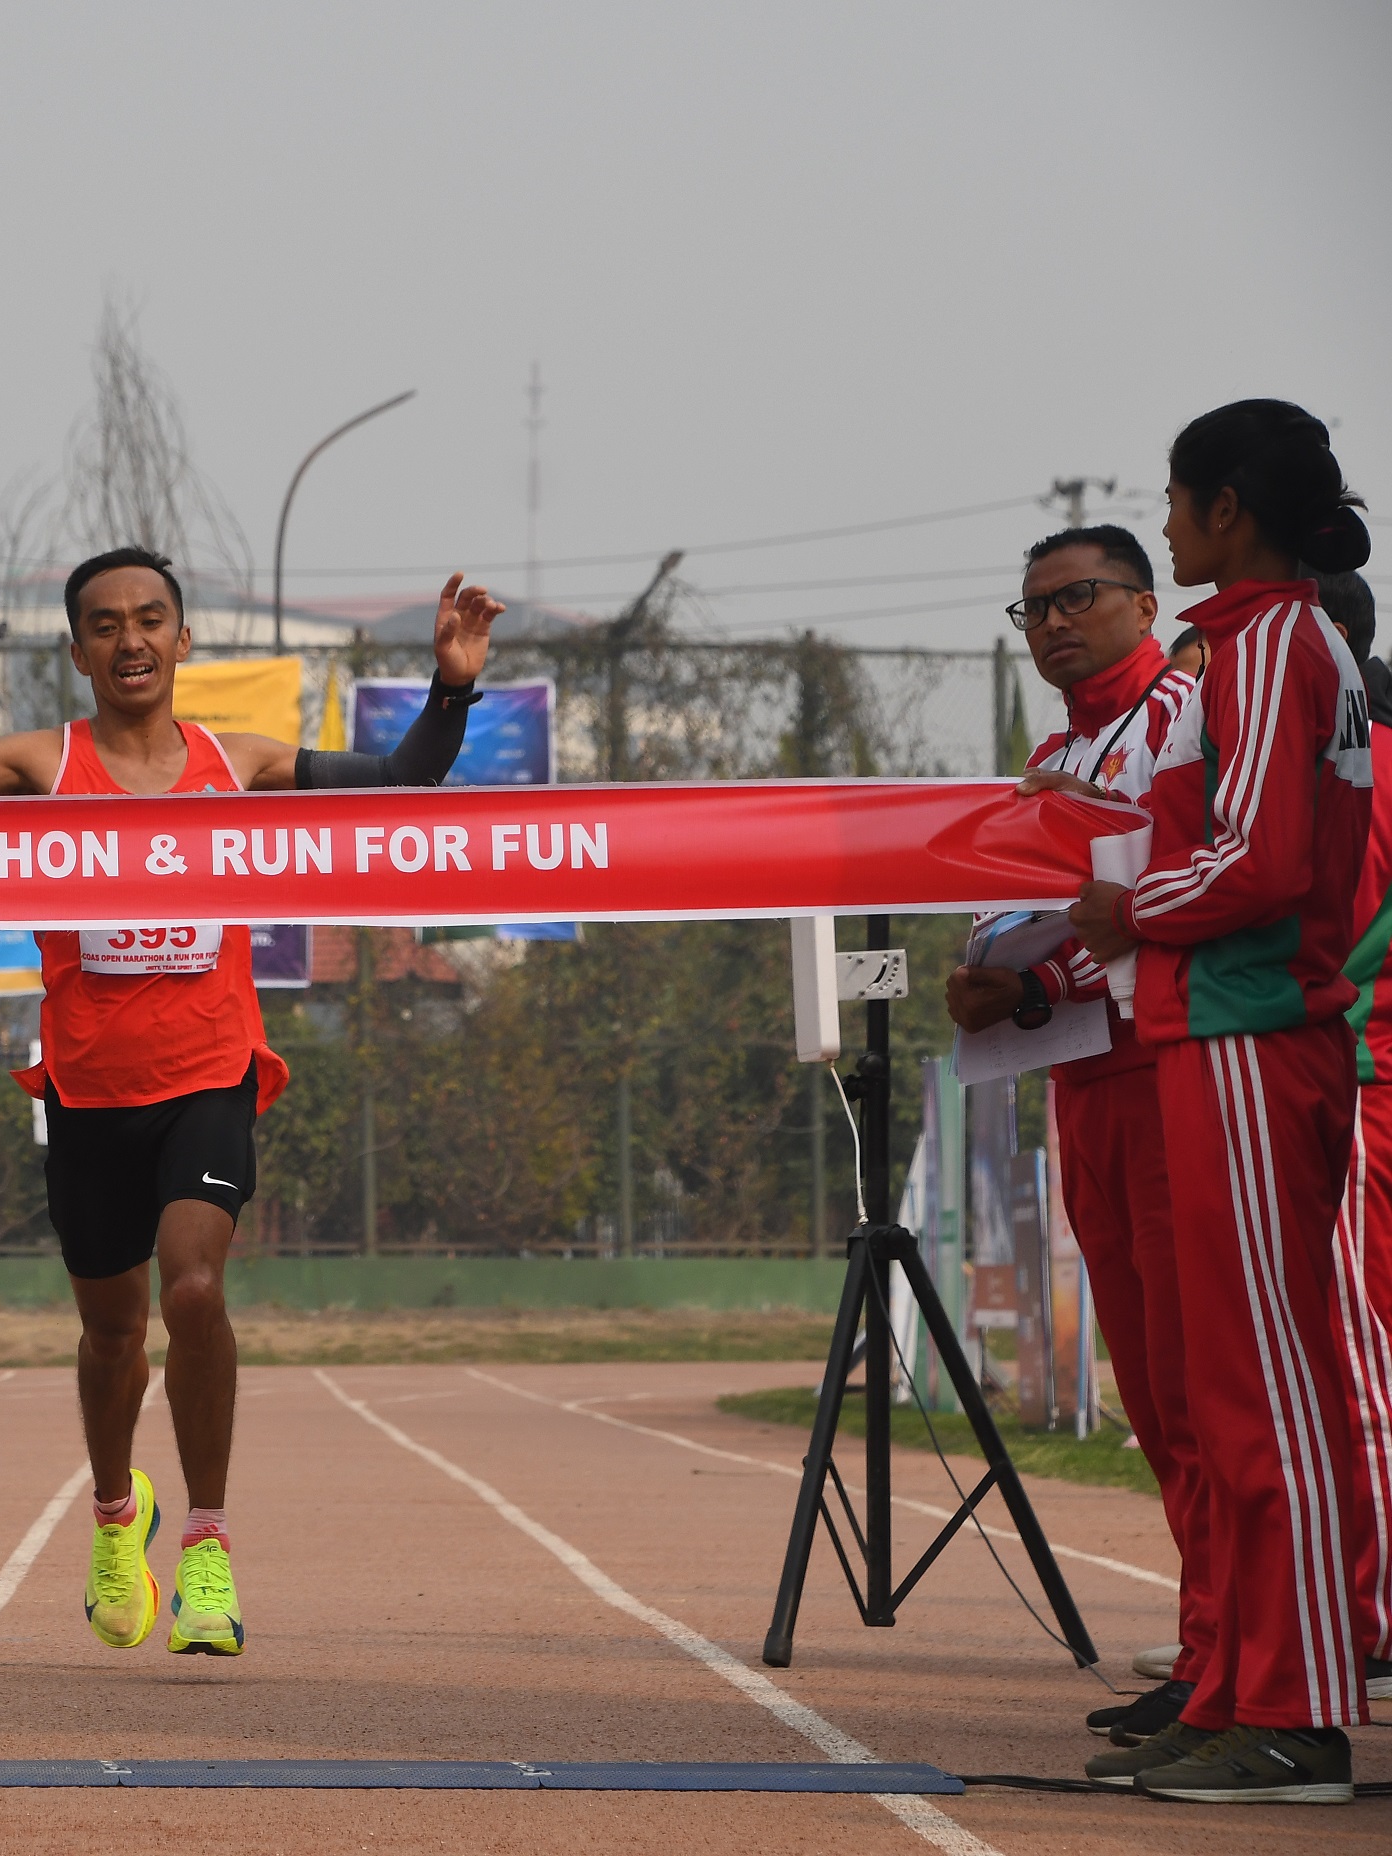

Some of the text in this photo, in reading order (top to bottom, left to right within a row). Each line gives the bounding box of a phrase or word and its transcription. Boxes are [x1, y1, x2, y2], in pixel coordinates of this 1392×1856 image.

[144, 833, 189, 875] &
[211, 827, 333, 876] RUN
[354, 825, 473, 874] FOR
[491, 823, 609, 871] FUN
[107, 926, 198, 950] 395
[82, 953, 100, 962] COAS
[101, 954, 121, 963] OPEN
[122, 954, 165, 963] MARATHON
[166, 954, 172, 962] &
[173, 953, 189, 961] RUN
